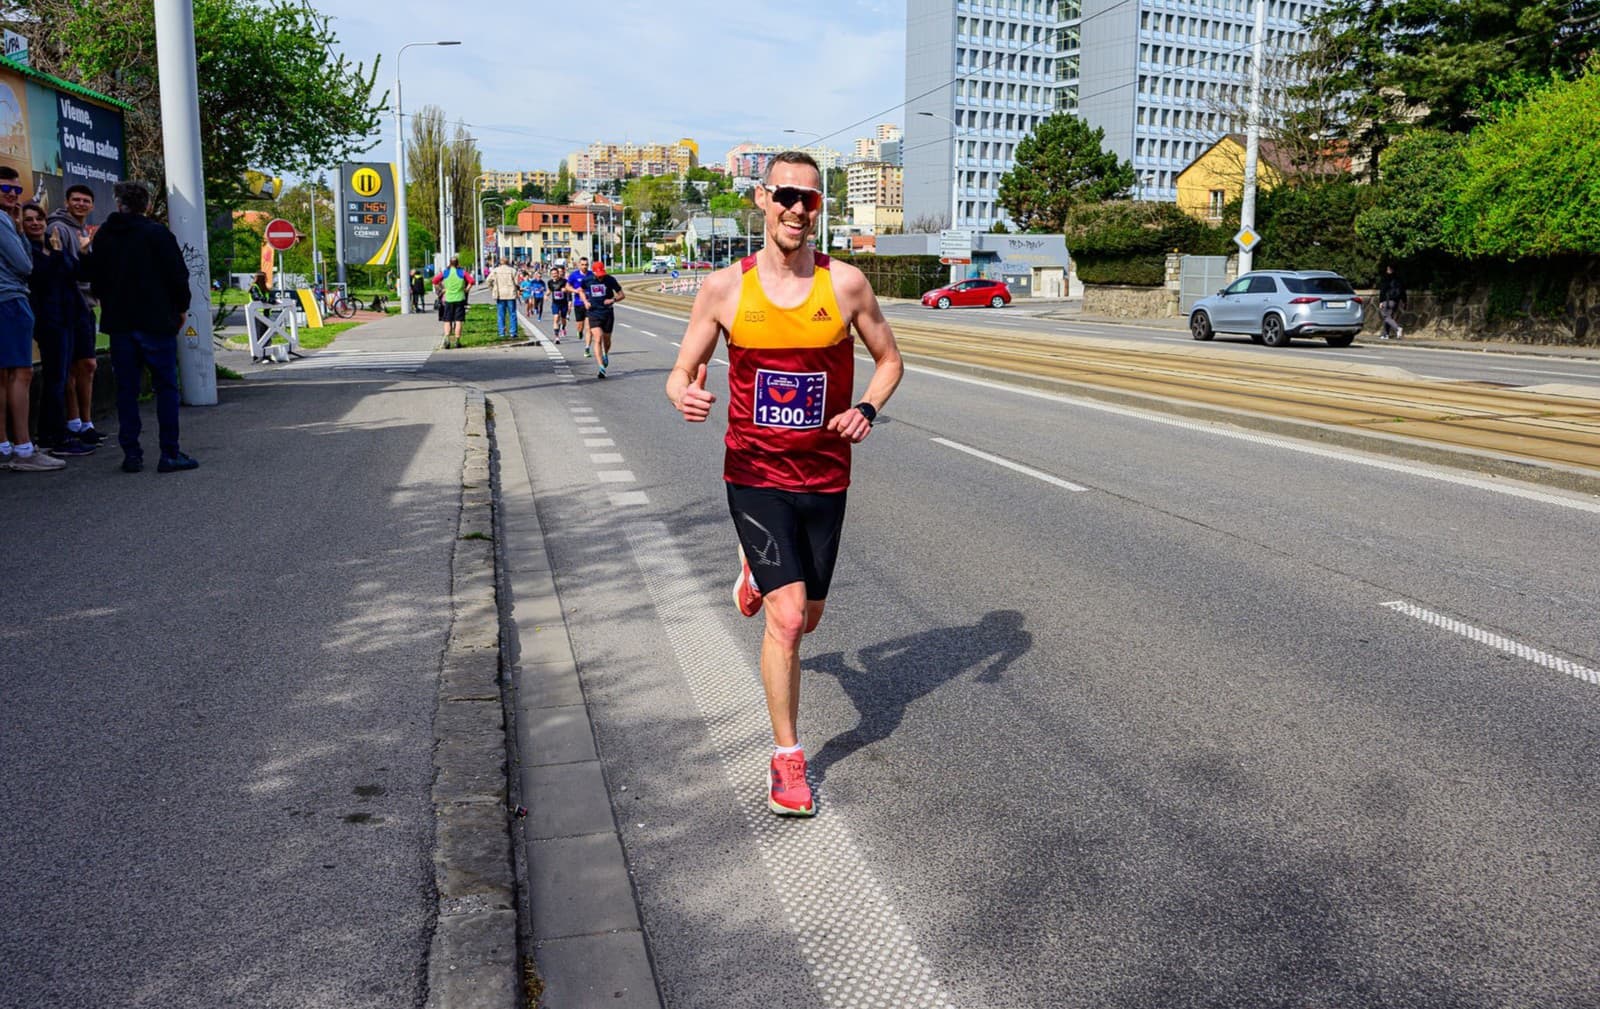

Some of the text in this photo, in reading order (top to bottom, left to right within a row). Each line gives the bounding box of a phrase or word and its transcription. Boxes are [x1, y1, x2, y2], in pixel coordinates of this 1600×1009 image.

[60, 98, 93, 129] Vieme,
[63, 126, 119, 160] čo vám sadne
[758, 405, 805, 425] 1300
